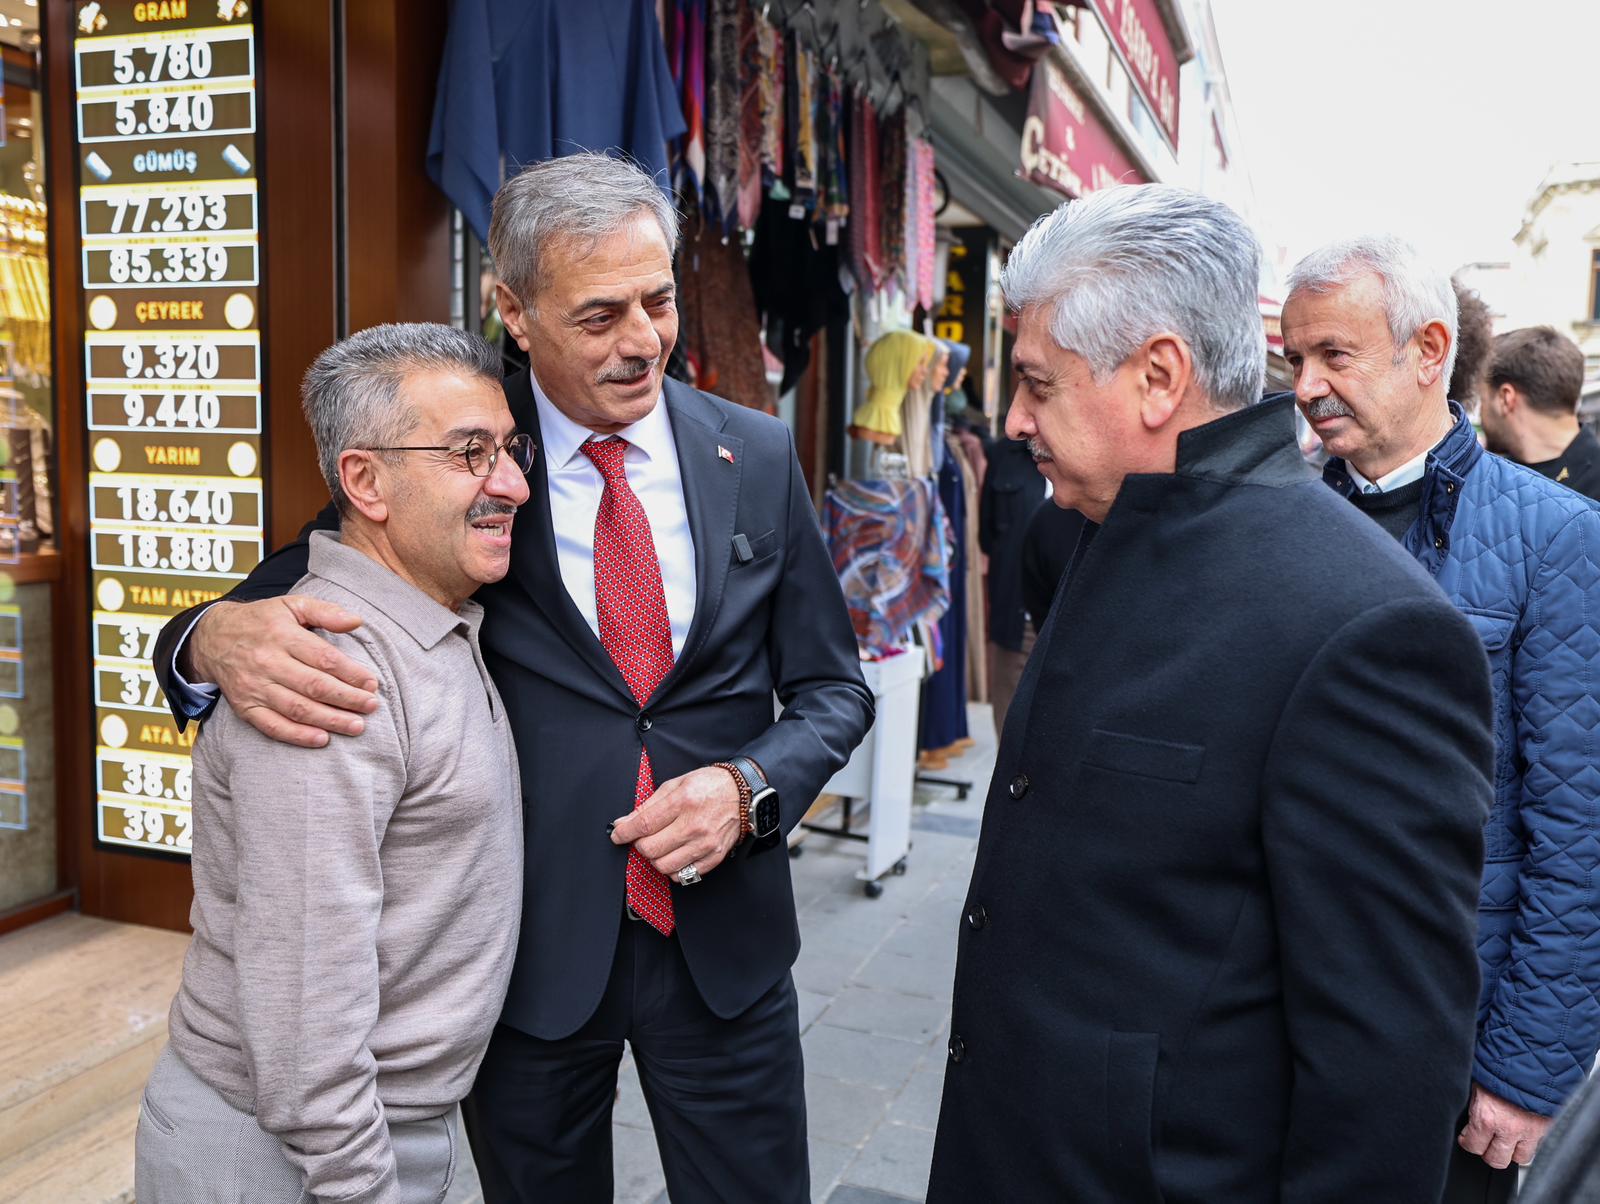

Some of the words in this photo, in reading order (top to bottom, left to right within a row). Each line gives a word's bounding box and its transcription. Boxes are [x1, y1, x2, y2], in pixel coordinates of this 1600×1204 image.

[133, 1, 188, 22] GRAM
[114, 41, 212, 84] 5.780
[115, 94, 214, 135] 5.840
[133, 148, 198, 174] GÜMÜŞ
[106, 192, 228, 234] 77.293
[109, 246, 229, 283] 85.339
[135, 301, 205, 323] ÇEYREK
[121, 344, 220, 379] 9.320
[123, 393, 221, 429] 9.440
[144, 446, 201, 466] YARIM
[116, 487, 233, 525] 18.640
[118, 534, 234, 573] 18.880
[128, 585, 167, 606] TAM
[139, 724, 175, 745] ATA
